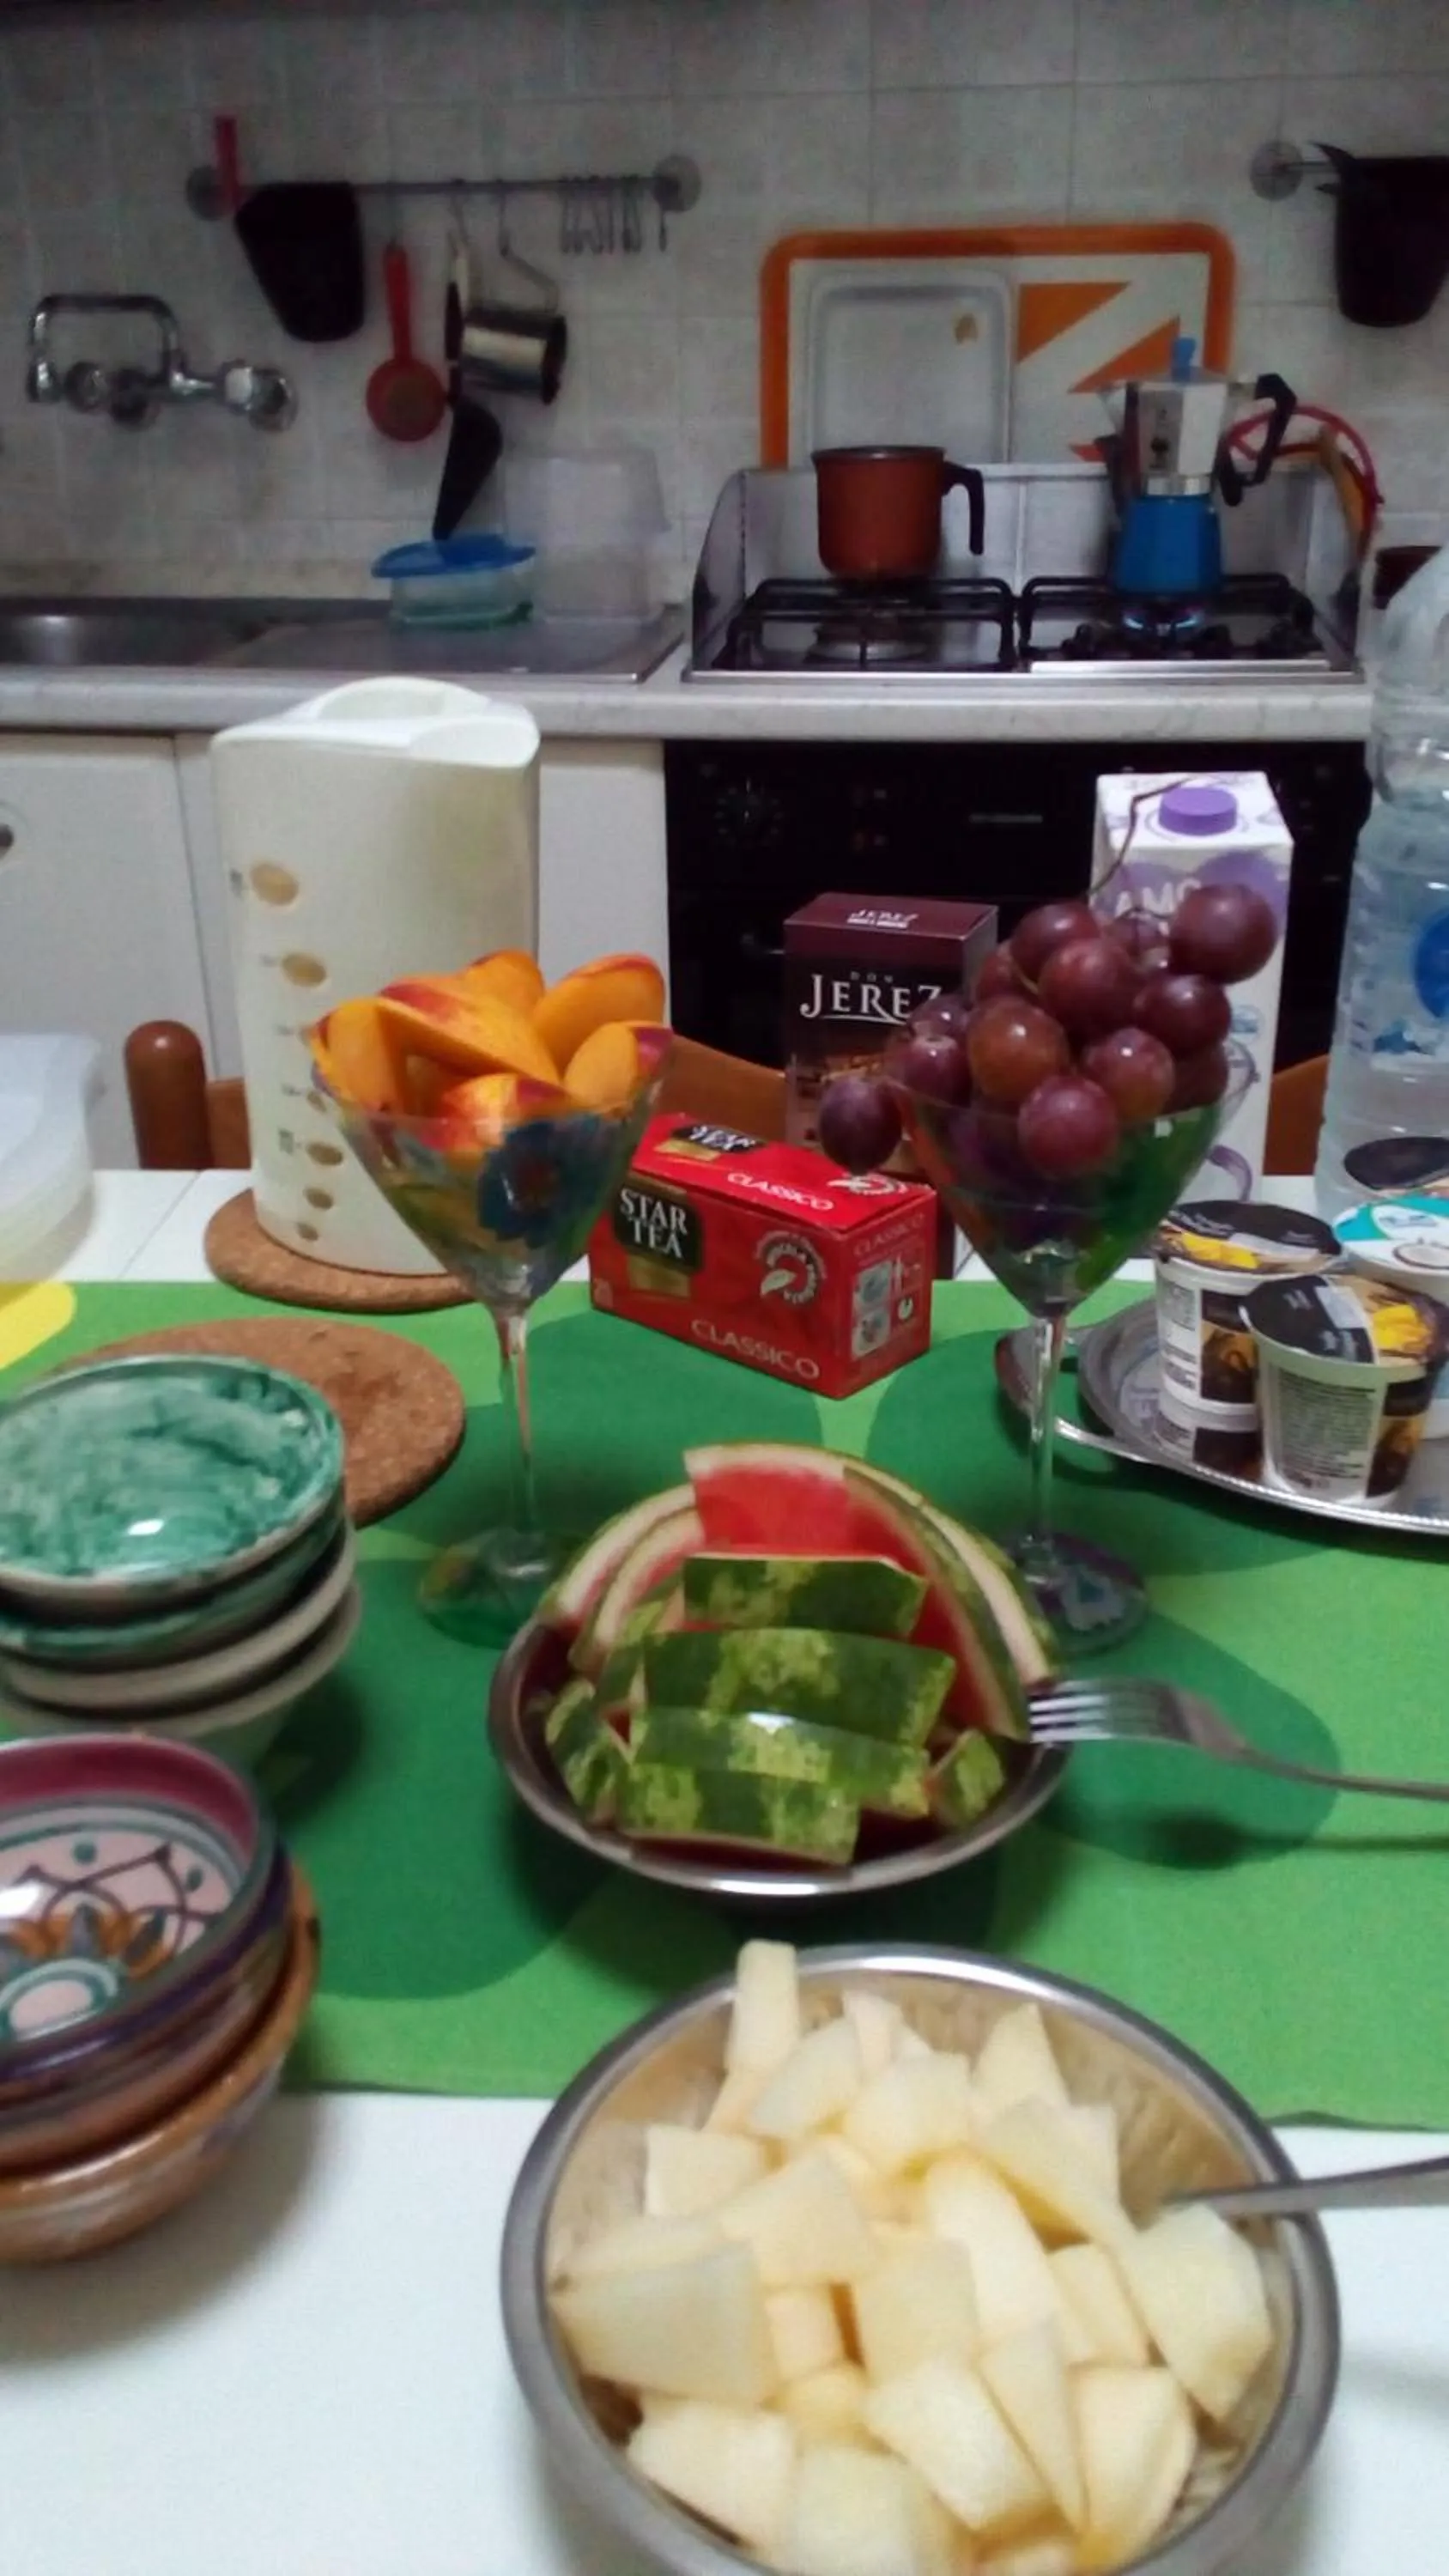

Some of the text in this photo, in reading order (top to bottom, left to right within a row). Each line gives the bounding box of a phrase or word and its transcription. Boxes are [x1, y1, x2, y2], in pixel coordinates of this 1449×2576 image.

[619, 1187, 688, 1235] STAR
[727, 1172, 834, 1211] CLASSICO
[627, 1214, 683, 1259] TEA
[691, 1318, 820, 1379] CLASSICO
